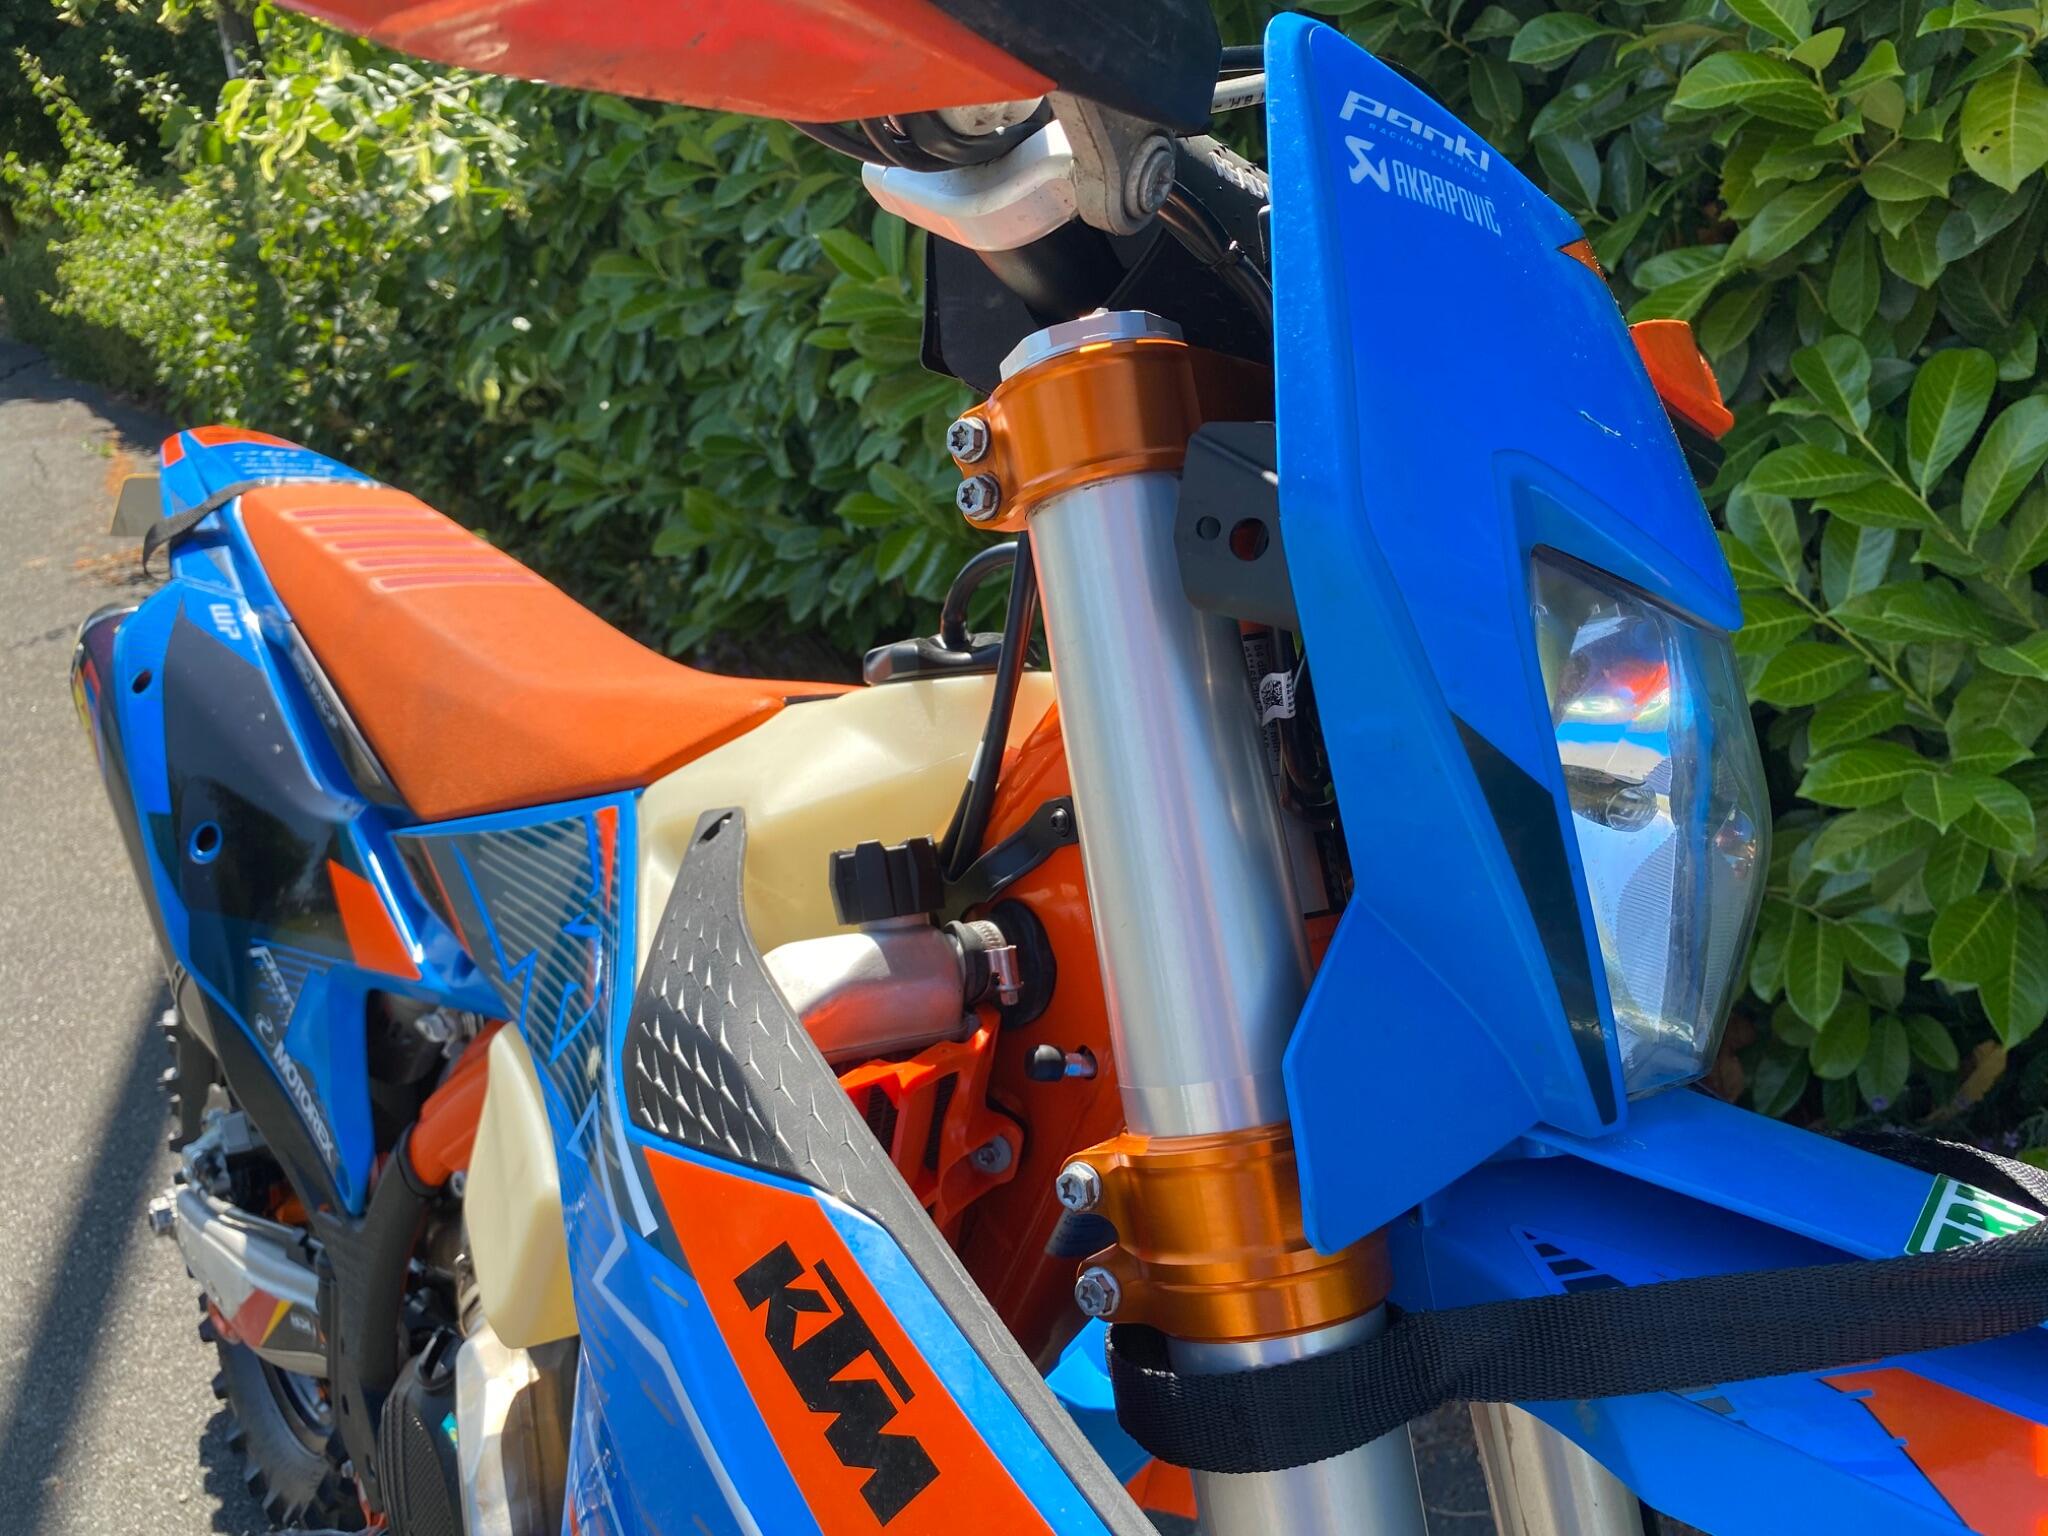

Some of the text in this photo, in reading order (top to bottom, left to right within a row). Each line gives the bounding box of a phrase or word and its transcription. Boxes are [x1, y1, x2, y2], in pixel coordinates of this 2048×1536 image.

[1368, 122, 1424, 150] RACING
[272, 1039, 334, 1164] MOTOREX
[733, 1240, 940, 1528] KTM
